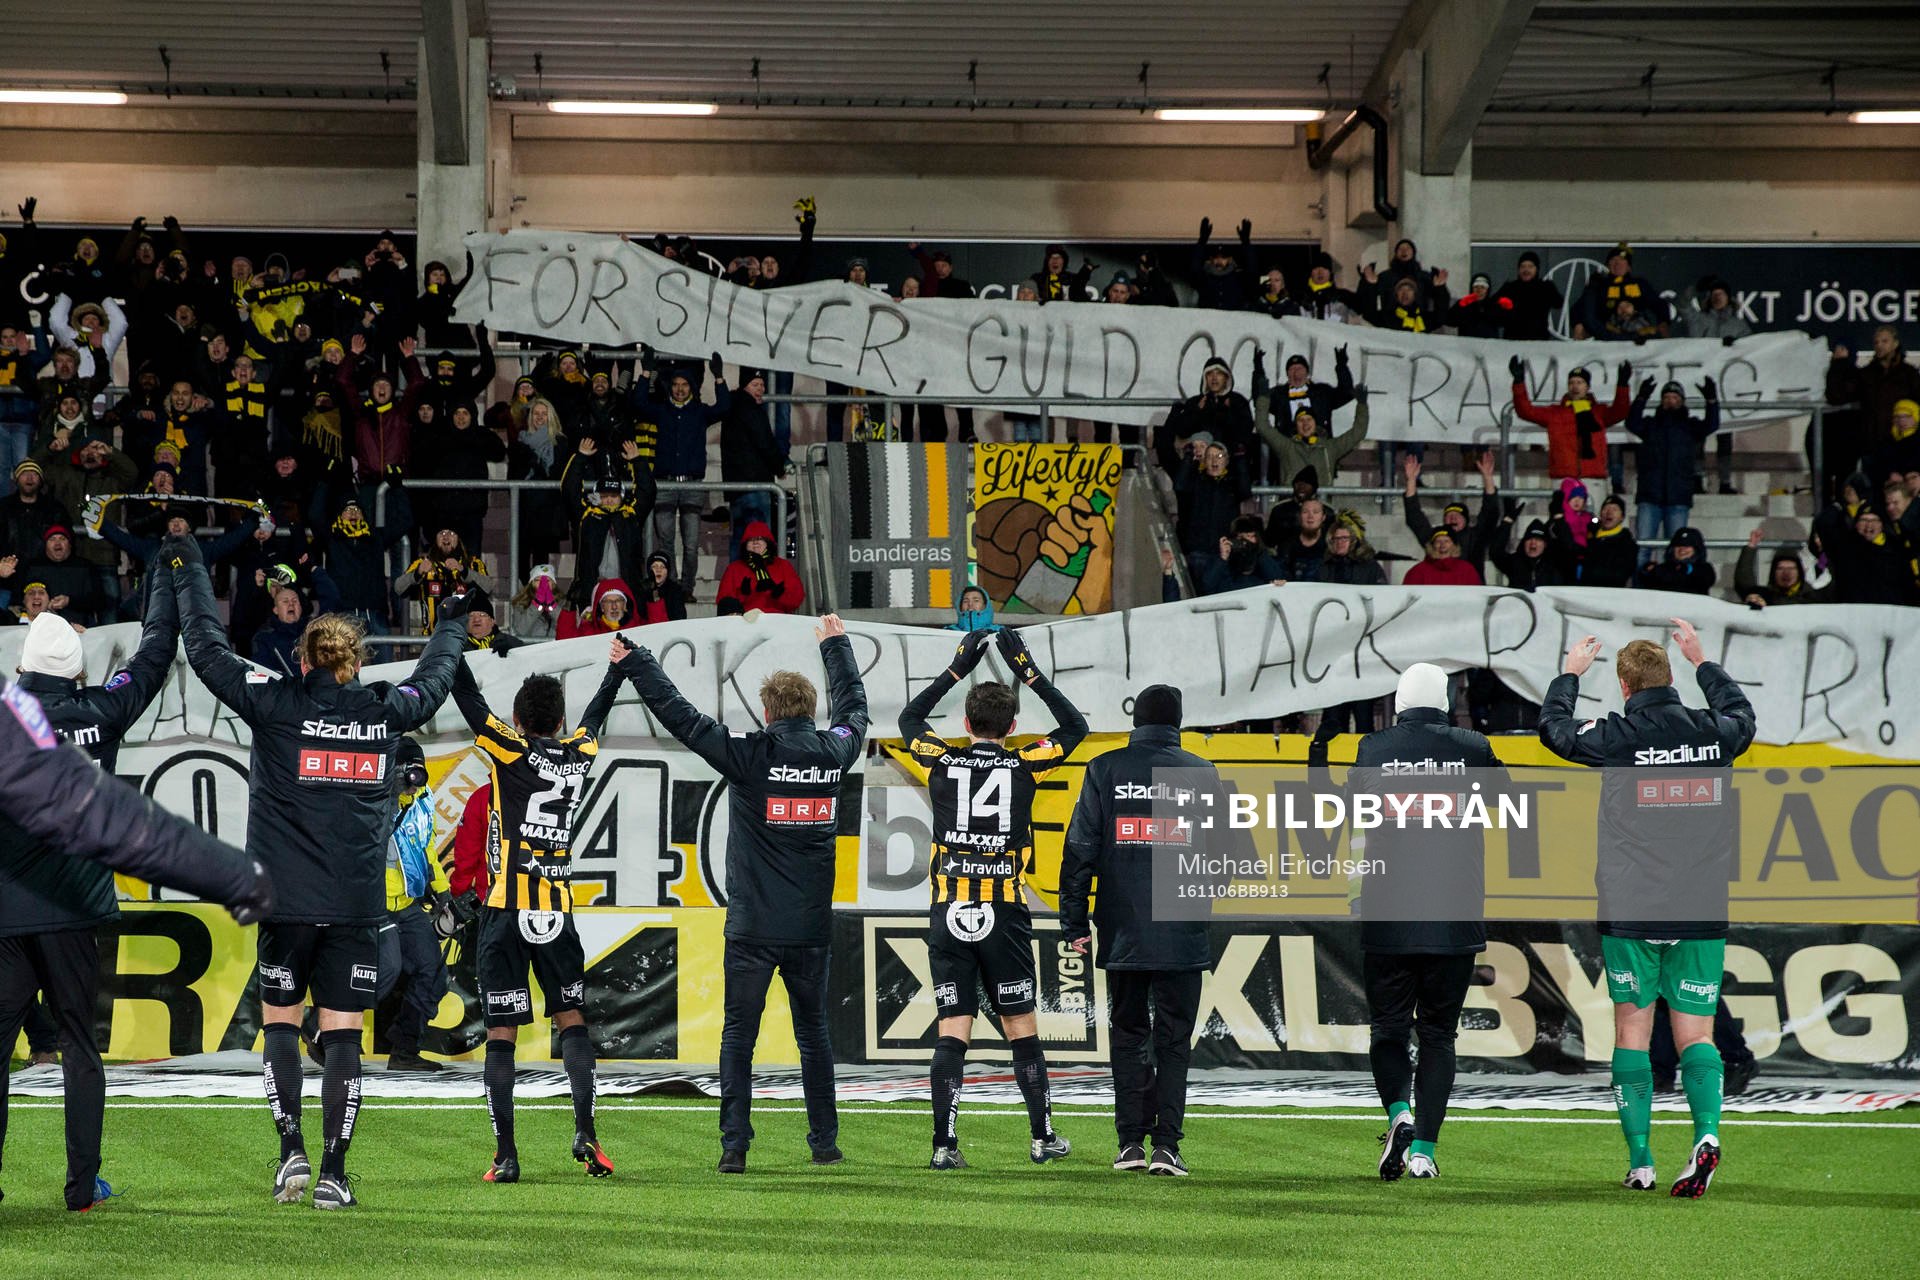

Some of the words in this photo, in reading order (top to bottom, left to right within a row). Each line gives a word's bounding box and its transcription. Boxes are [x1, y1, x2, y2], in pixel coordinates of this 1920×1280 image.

[1660, 291, 1781, 323] SKT
[484, 242, 628, 331] FÖR
[655, 267, 928, 395] SILVER,
[966, 314, 1141, 400] GULD
[979, 442, 1122, 498] Lifestyle
[849, 544, 952, 563] bandieras
[1192, 592, 1419, 698] TACK
[1013, 652, 1029, 667] 14
[301, 718, 387, 741] stadium
[939, 753, 1020, 769] EHRENBORG
[1634, 740, 1721, 766] stadium
[306, 757, 374, 773] BRA
[767, 764, 843, 784] stadium
[1380, 757, 1466, 777] stadium
[947, 766, 1012, 832] 14
[1643, 784, 1710, 798] BRA
[772, 804, 829, 816] BRA
[491, 819, 500, 864] BOHUS
[944, 830, 1007, 847] MAXXIS
[976, 845, 1006, 853] TYRES
[962, 858, 1012, 875] bravida
[488, 991, 527, 1006] kungälvs
[514, 998, 527, 1012] trä
